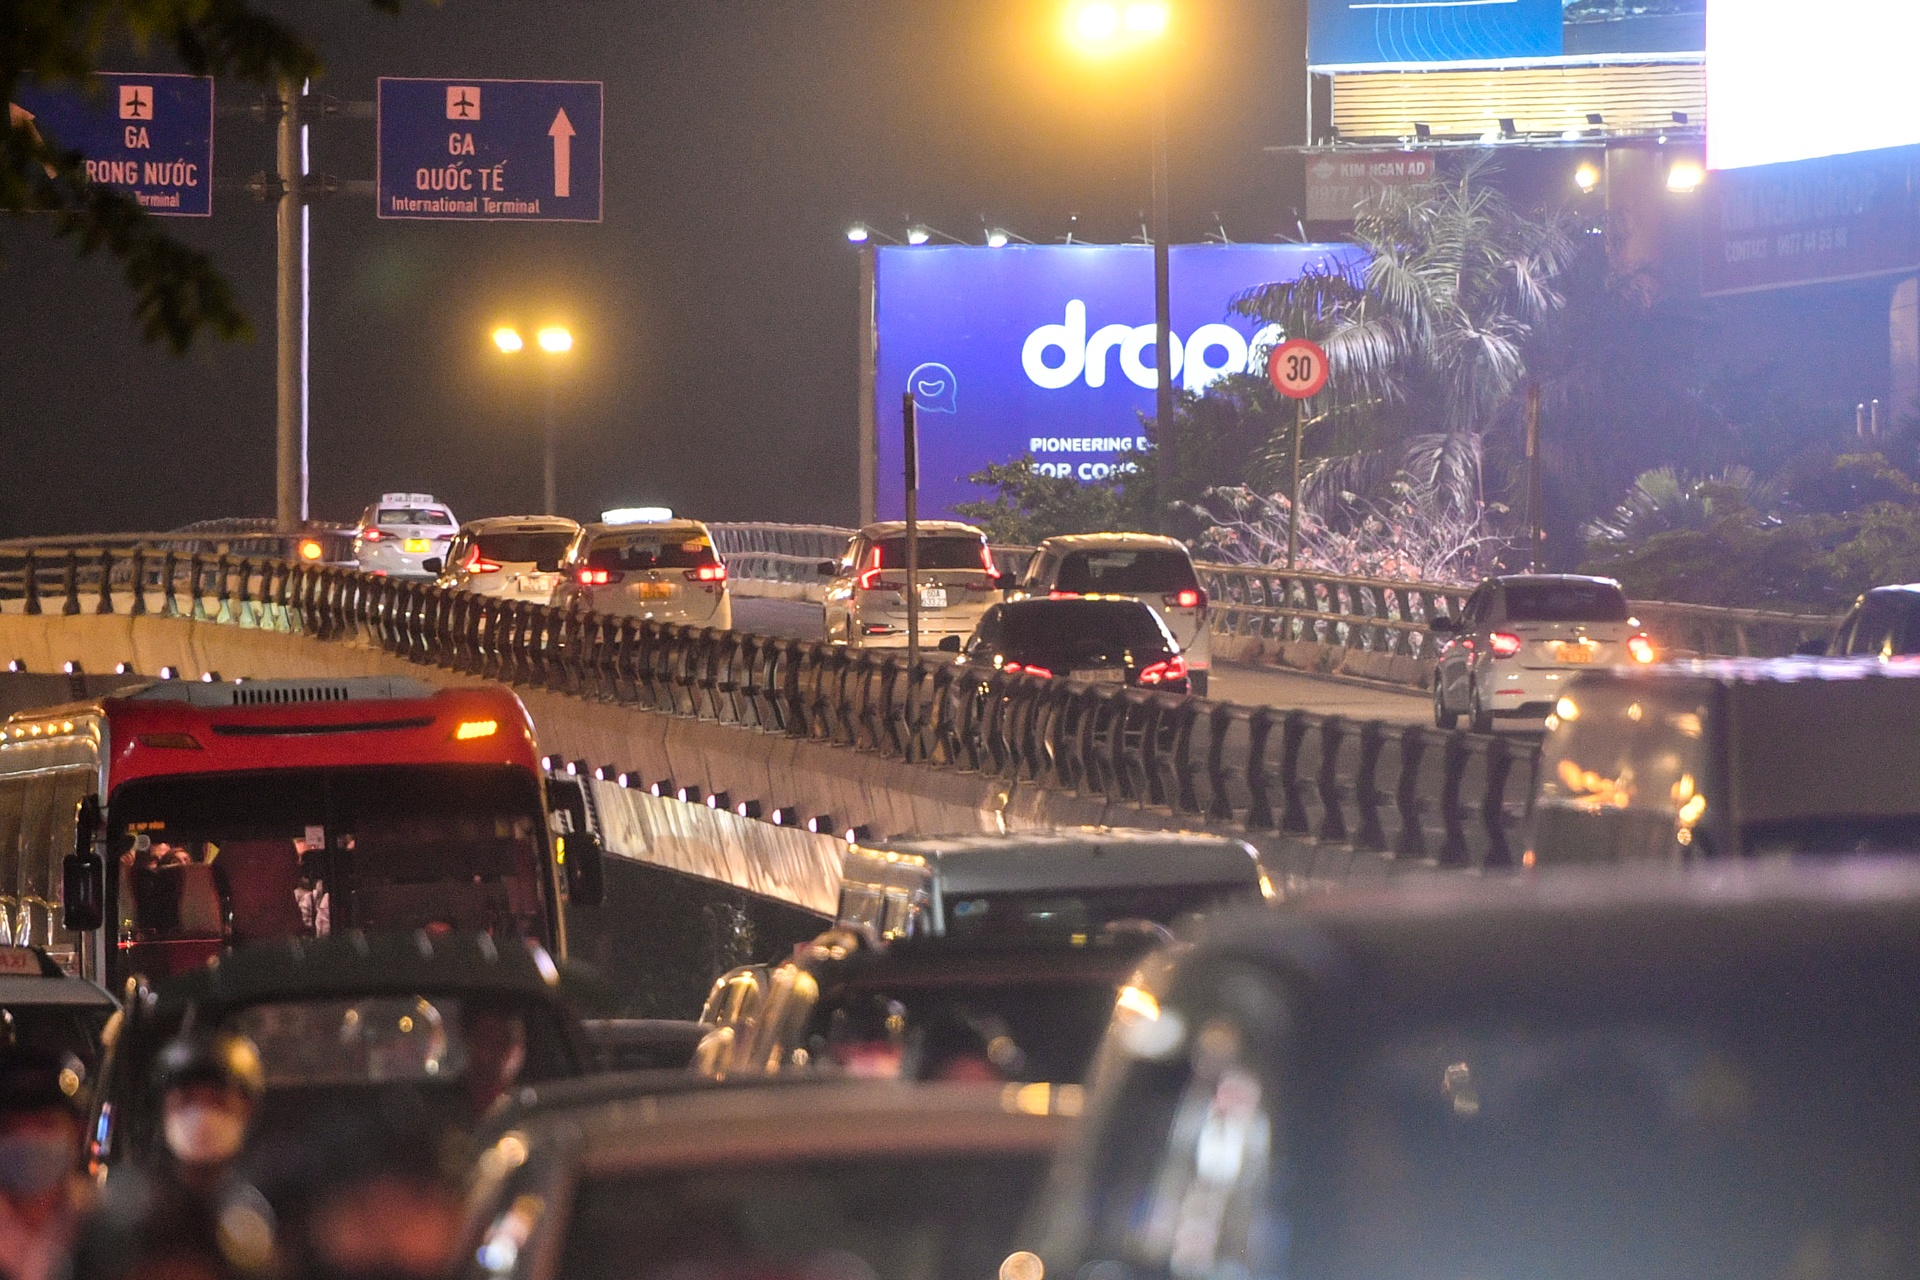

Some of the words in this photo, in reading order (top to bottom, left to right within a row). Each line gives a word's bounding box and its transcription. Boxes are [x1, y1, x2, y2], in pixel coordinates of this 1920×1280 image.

[124, 125, 150, 149] GA
[449, 132, 475, 155] GA
[82, 159, 138, 184] RONG
[144, 158, 198, 187] NƯỚC
[416, 161, 472, 191] QUỐC
[478, 160, 508, 191] TẾ
[1340, 163, 1365, 177] KIM
[1408, 161, 1426, 175] AD
[392, 196, 477, 212] International
[482, 197, 540, 214] Terminal
[1286, 354, 1312, 382] 30
[1029, 437, 1133, 453] PIONEERING
